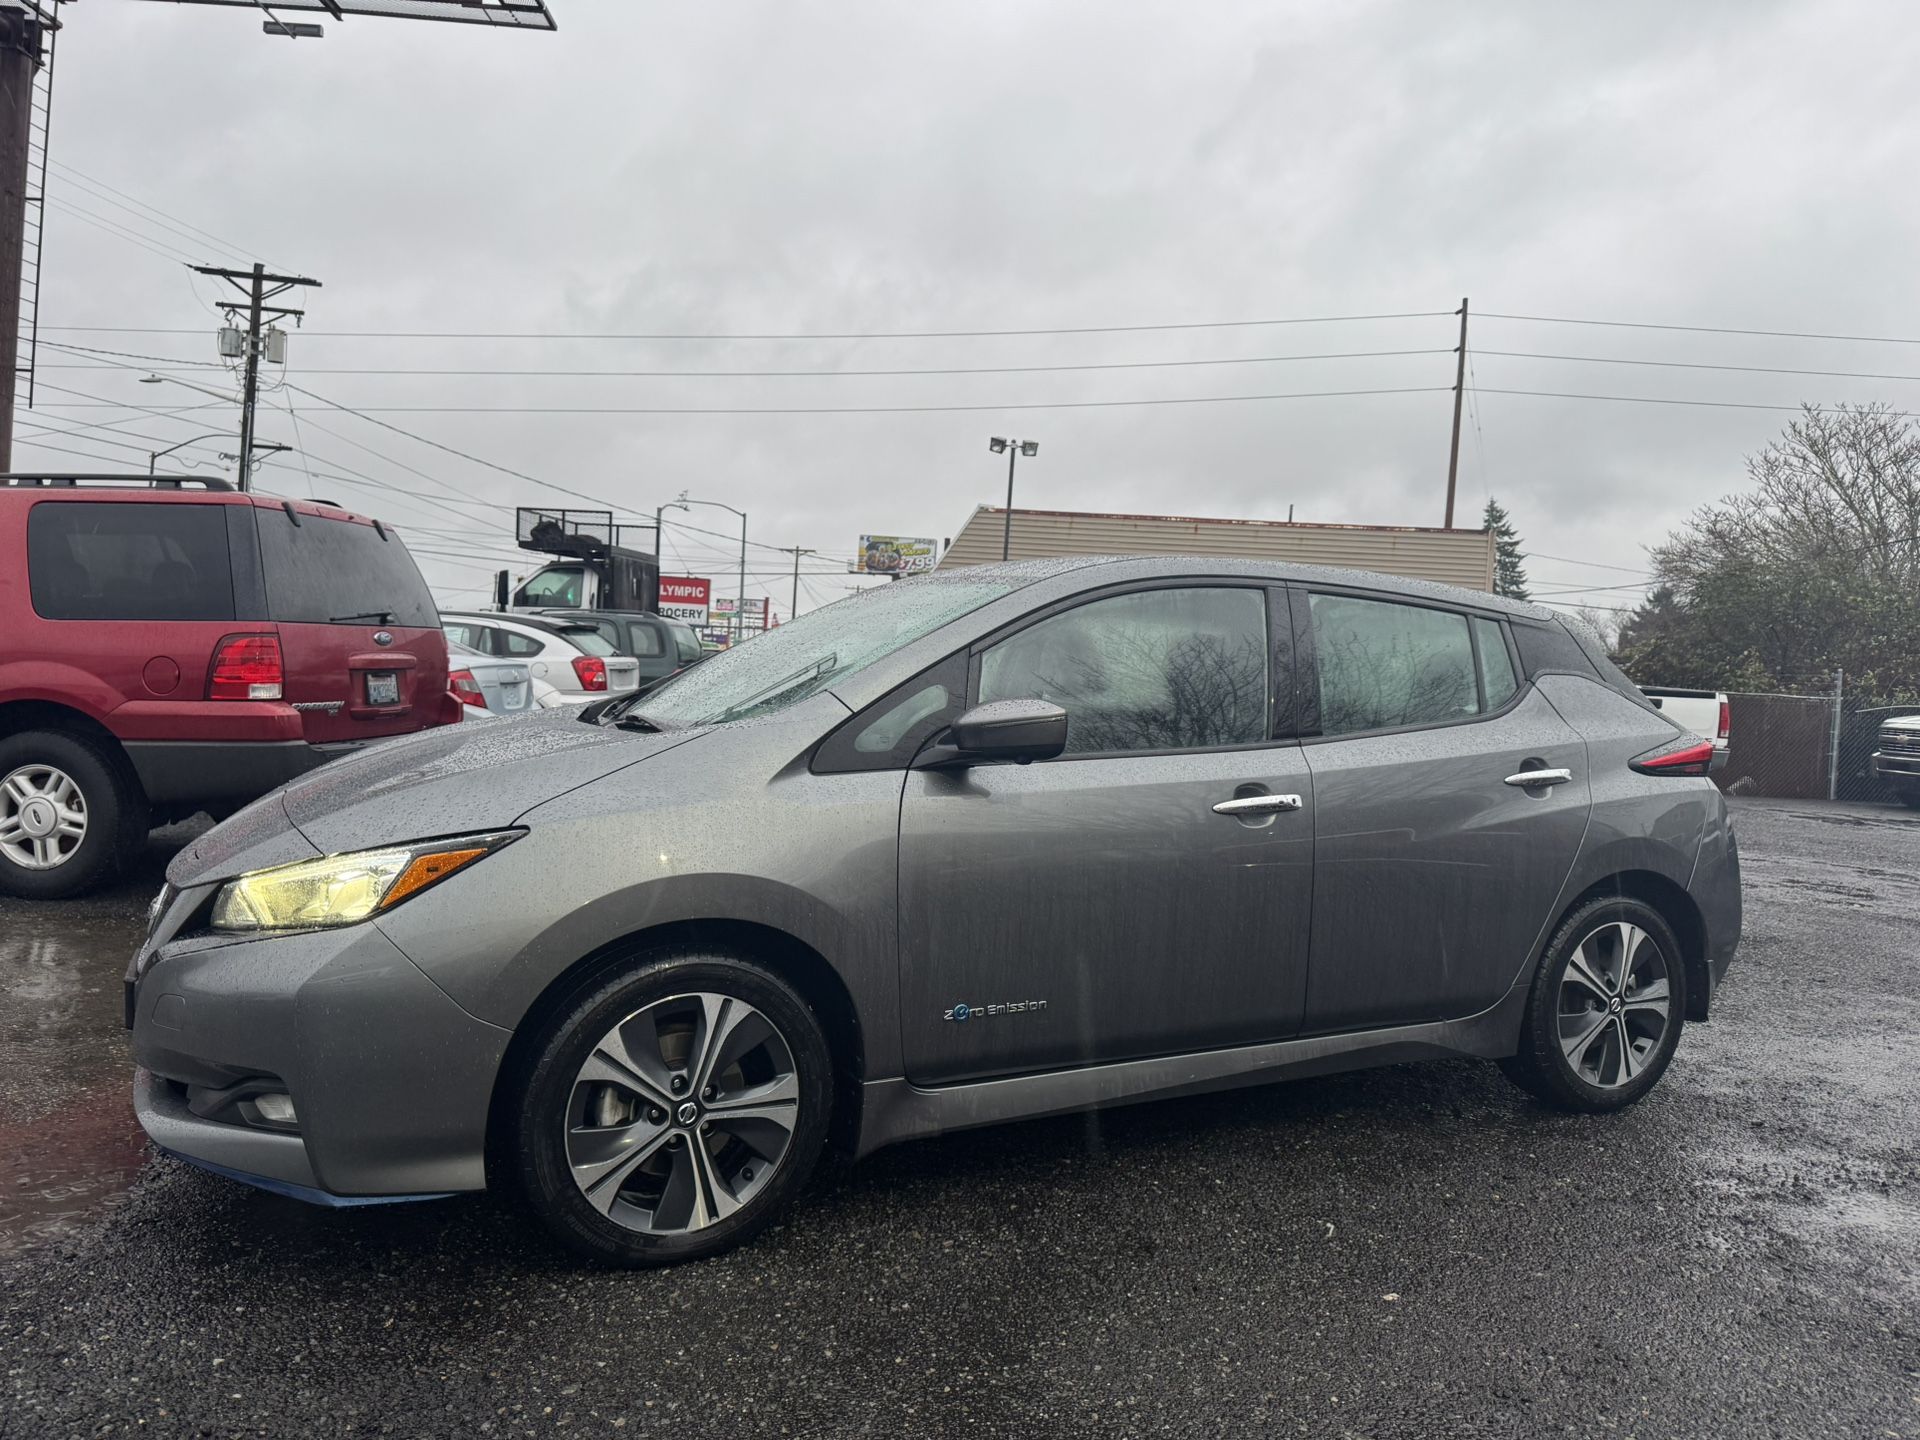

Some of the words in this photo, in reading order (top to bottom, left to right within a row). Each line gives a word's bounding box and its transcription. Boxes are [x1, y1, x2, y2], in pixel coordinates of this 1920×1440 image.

[899, 556, 935, 571] $7.99
[660, 584, 705, 598] LYMPIC
[659, 607, 704, 619] ROCERY
